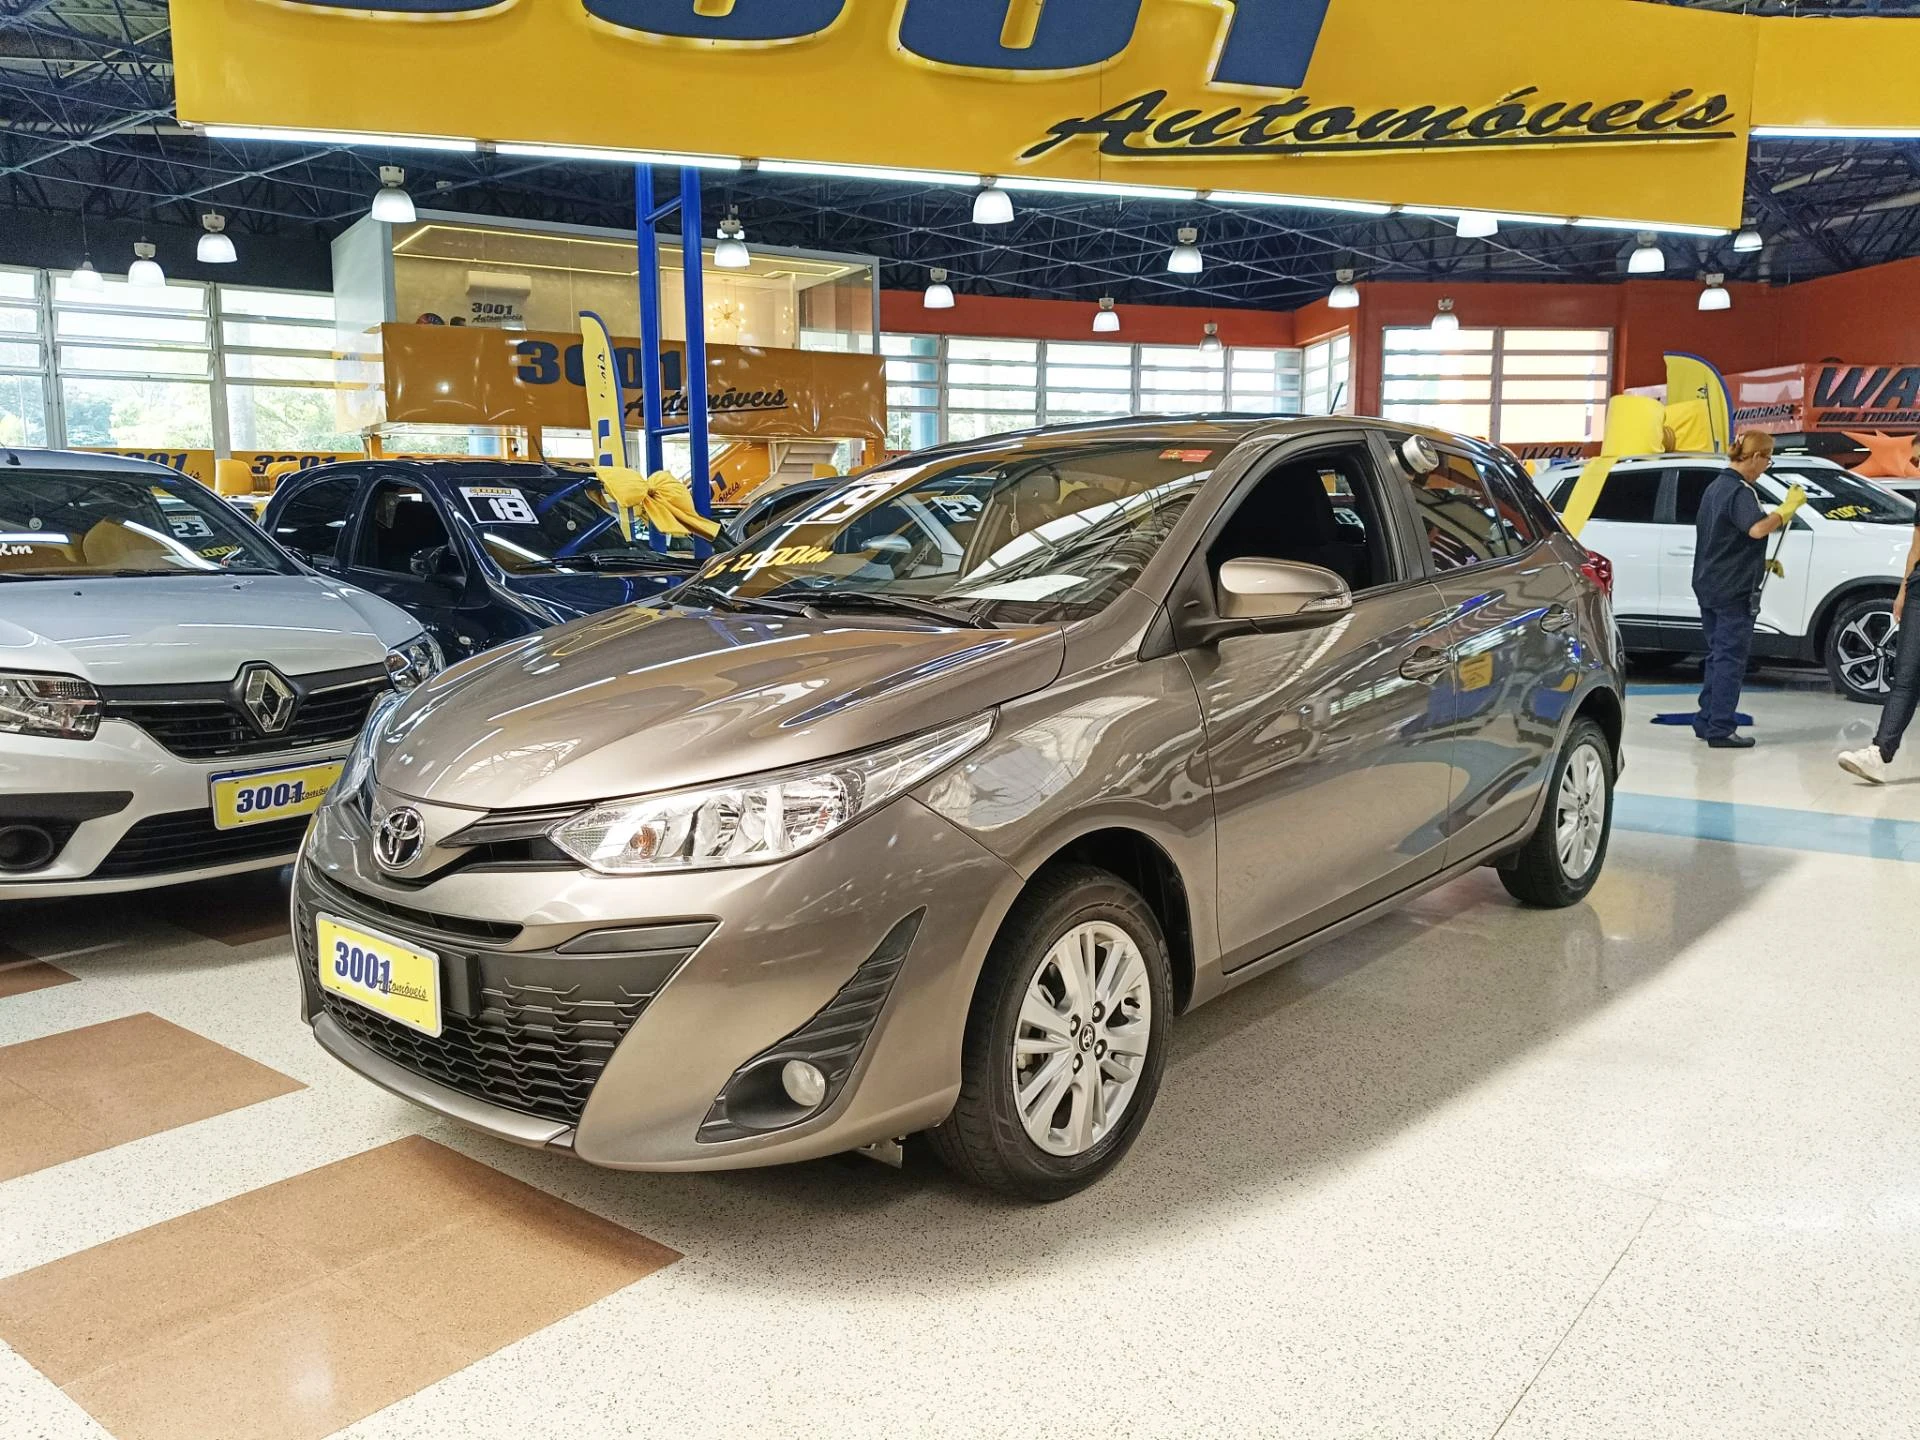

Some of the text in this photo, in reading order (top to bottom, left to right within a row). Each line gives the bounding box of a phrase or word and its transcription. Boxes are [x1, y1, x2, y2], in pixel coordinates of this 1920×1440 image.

[1021, 86, 1737, 156] Automóveis
[471, 302, 513, 316] 3001
[1520, 446, 1582, 460] WAY
[488, 497, 535, 522] 18
[236, 780, 303, 813] 3001
[335, 941, 391, 995] 3001
